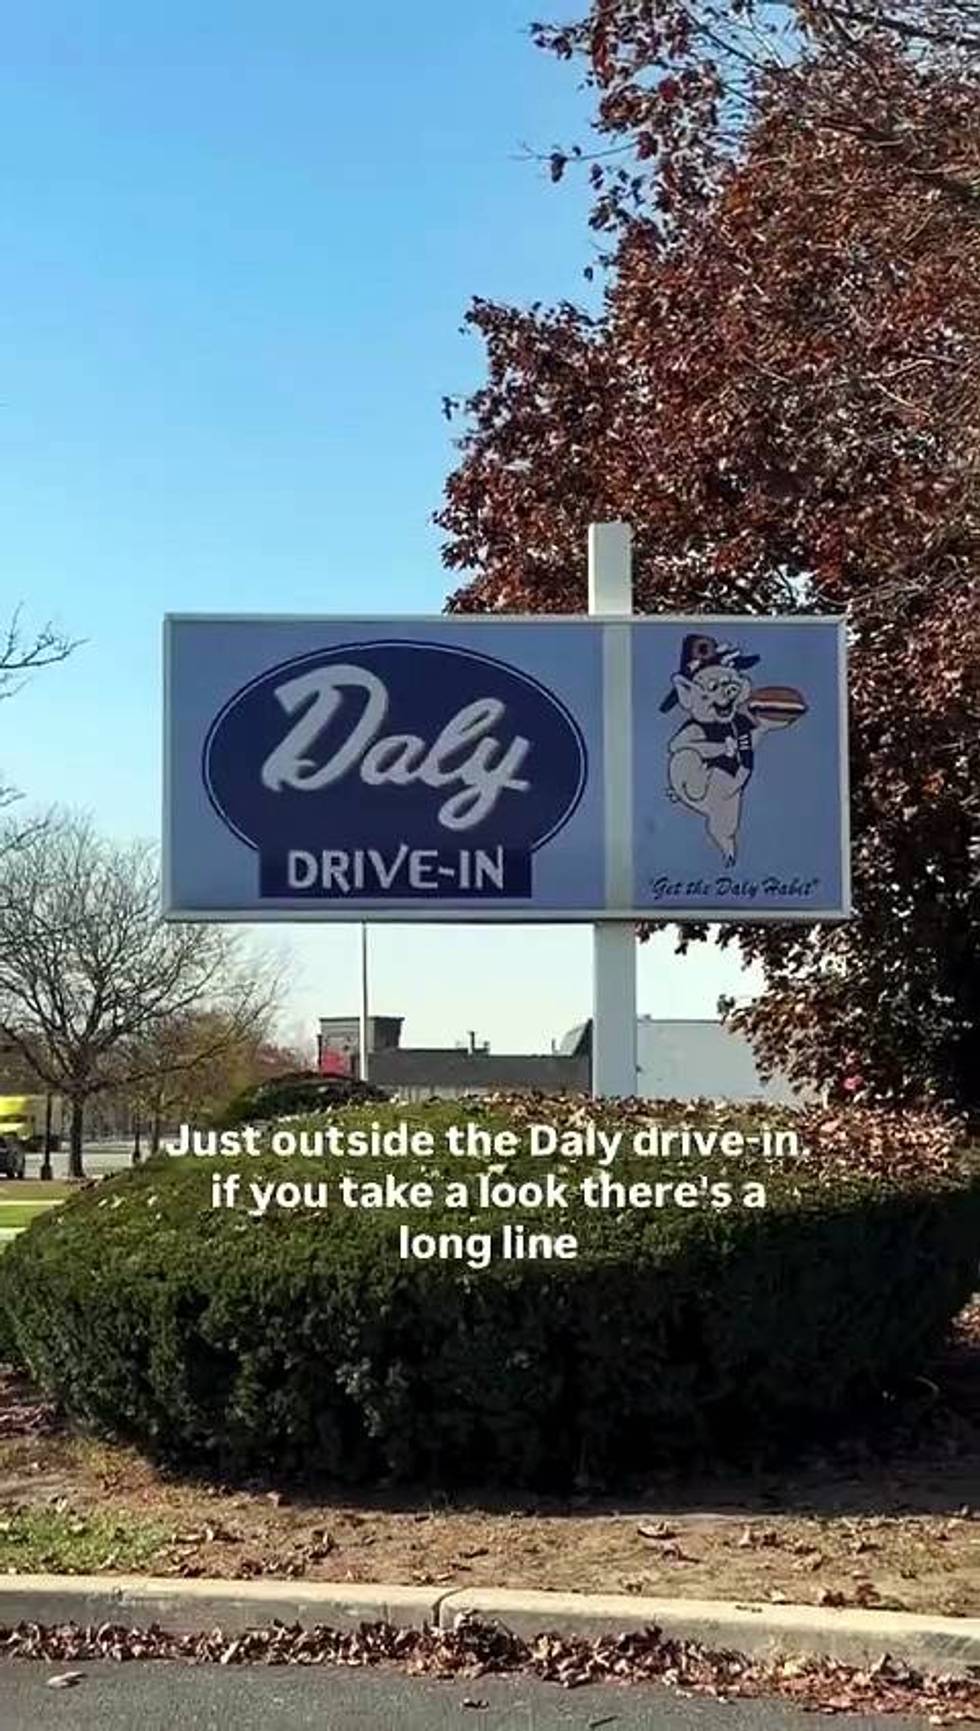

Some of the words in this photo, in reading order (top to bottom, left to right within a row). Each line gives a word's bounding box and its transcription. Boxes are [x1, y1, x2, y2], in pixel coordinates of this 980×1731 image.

[261, 663, 531, 830] Daly
[287, 845, 505, 892] DRIVE-IN
[686, 878, 710, 896] the
[716, 876, 759, 898] Daly
